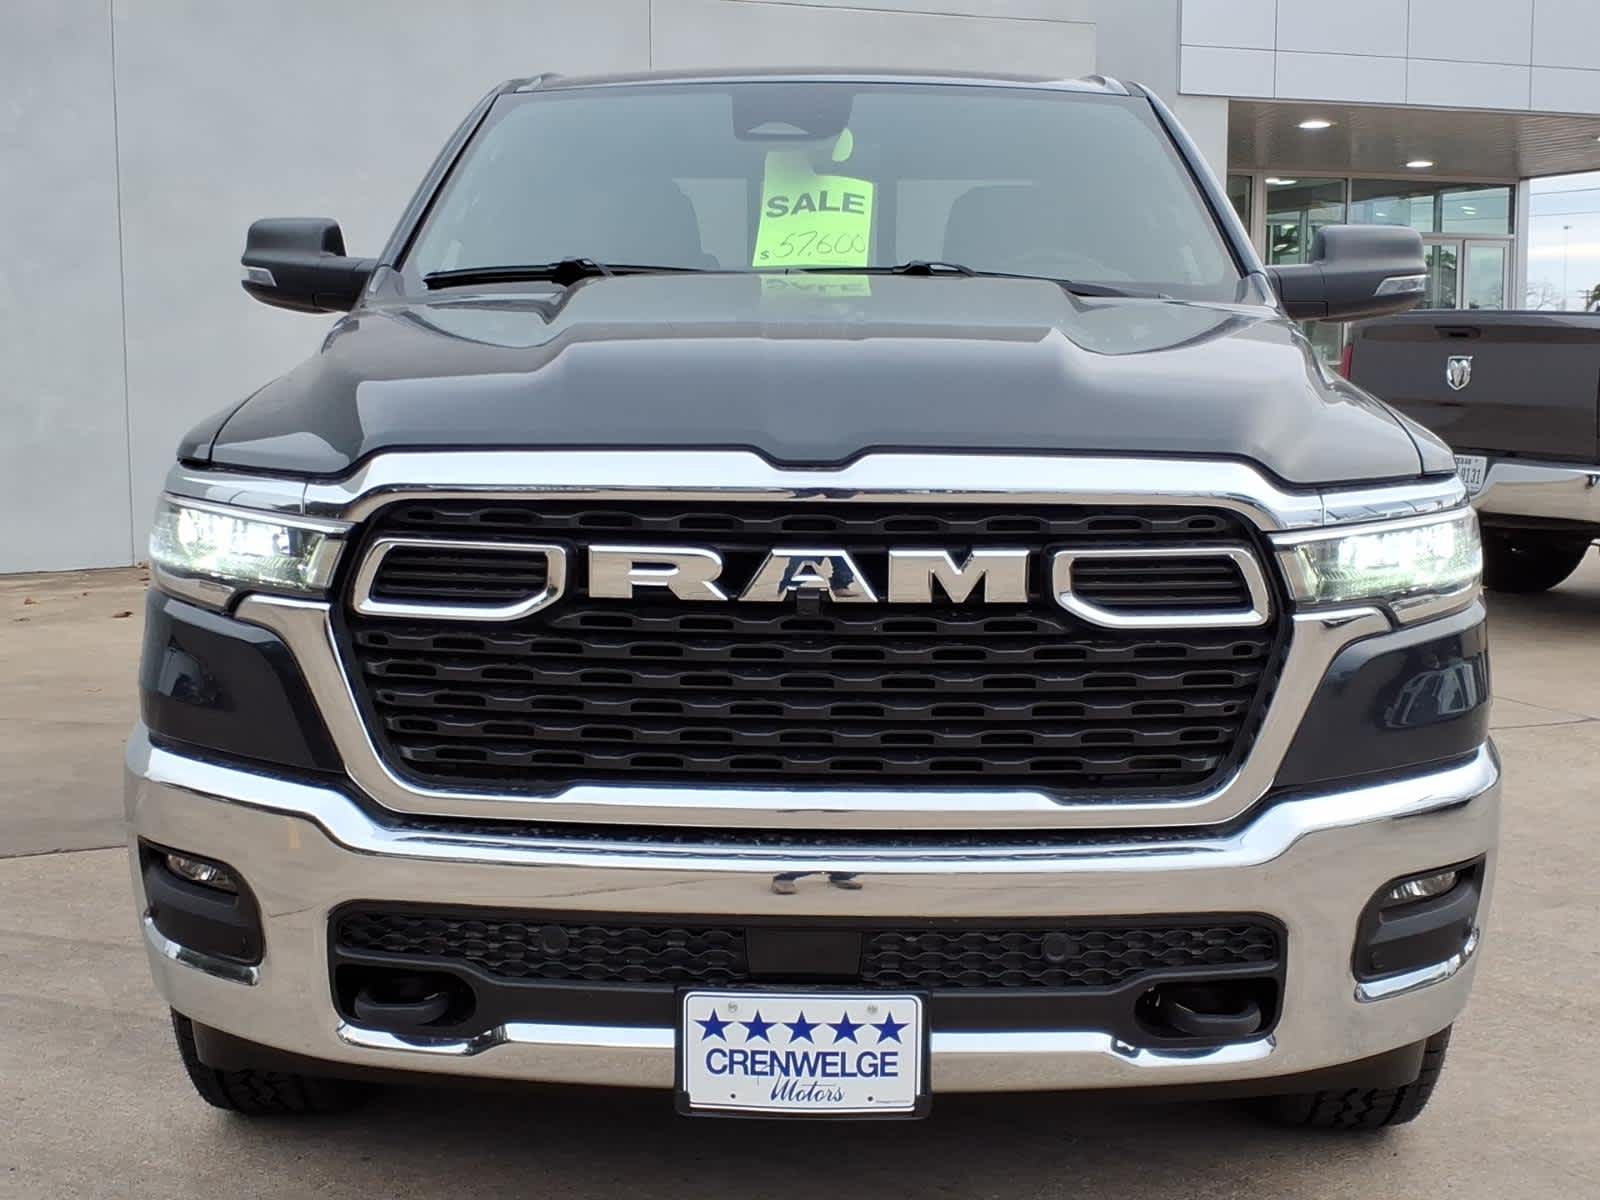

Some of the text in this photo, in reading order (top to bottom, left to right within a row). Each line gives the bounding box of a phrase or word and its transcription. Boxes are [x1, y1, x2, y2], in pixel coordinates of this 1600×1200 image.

[766, 190, 866, 218] SALE
[588, 544, 1031, 604] RAM
[705, 1048, 899, 1078] CRENWELGE
[770, 1072, 845, 1102] Motors
